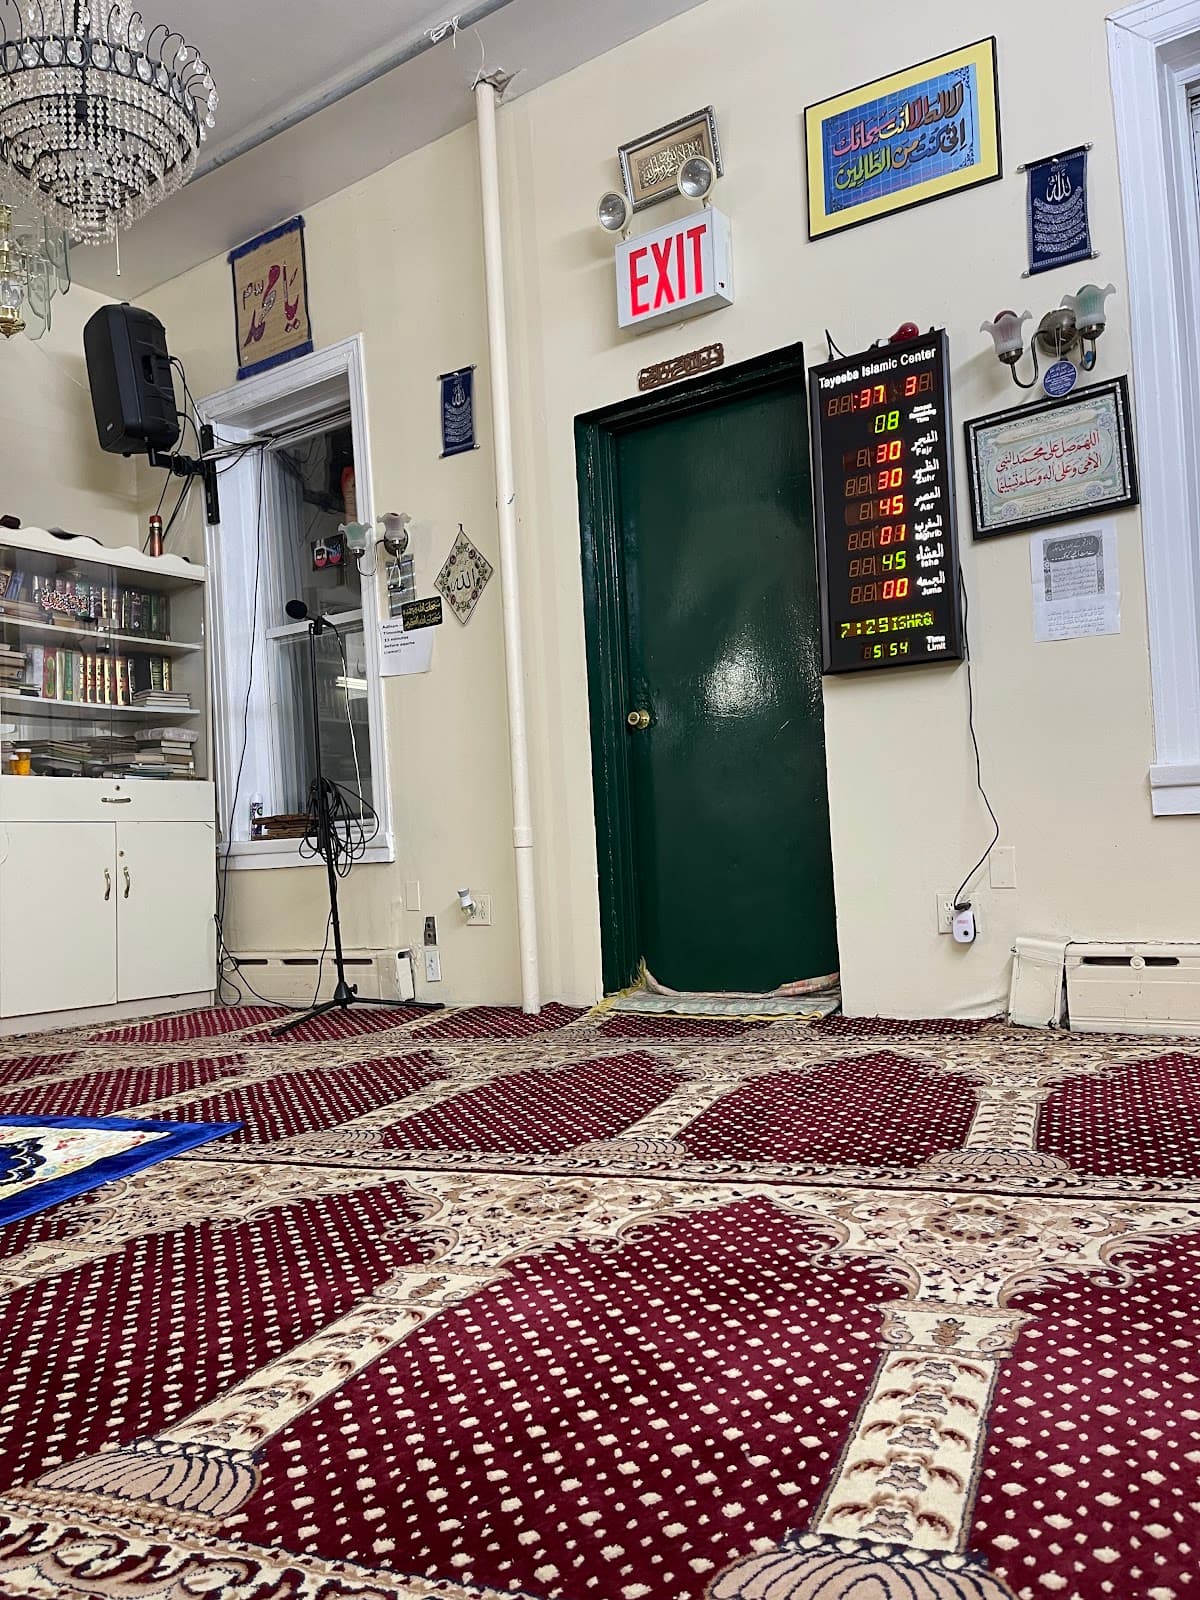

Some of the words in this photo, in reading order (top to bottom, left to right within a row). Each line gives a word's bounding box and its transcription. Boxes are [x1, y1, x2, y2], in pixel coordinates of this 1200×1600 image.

[629, 223, 707, 317] EXIT
[819, 368, 859, 389] Tayeeba
[861, 358, 898, 377] Islamic
[900, 348, 936, 366] Center
[874, 410, 899, 433] 08
[876, 440, 901, 463] 30
[911, 430, 938, 452] الفجر
[877, 467, 903, 490] 30
[916, 474, 935, 485] Zuhr
[879, 494, 904, 516] 45
[914, 486, 941, 507] العصر
[920, 501, 934, 511] Asr
[879, 523, 906, 546] 01
[882, 551, 907, 571] 45
[882, 578, 909, 600] 00
[921, 586, 942, 596] Juma
[926, 635, 946, 644] Time
[927, 641, 946, 652] Limit
